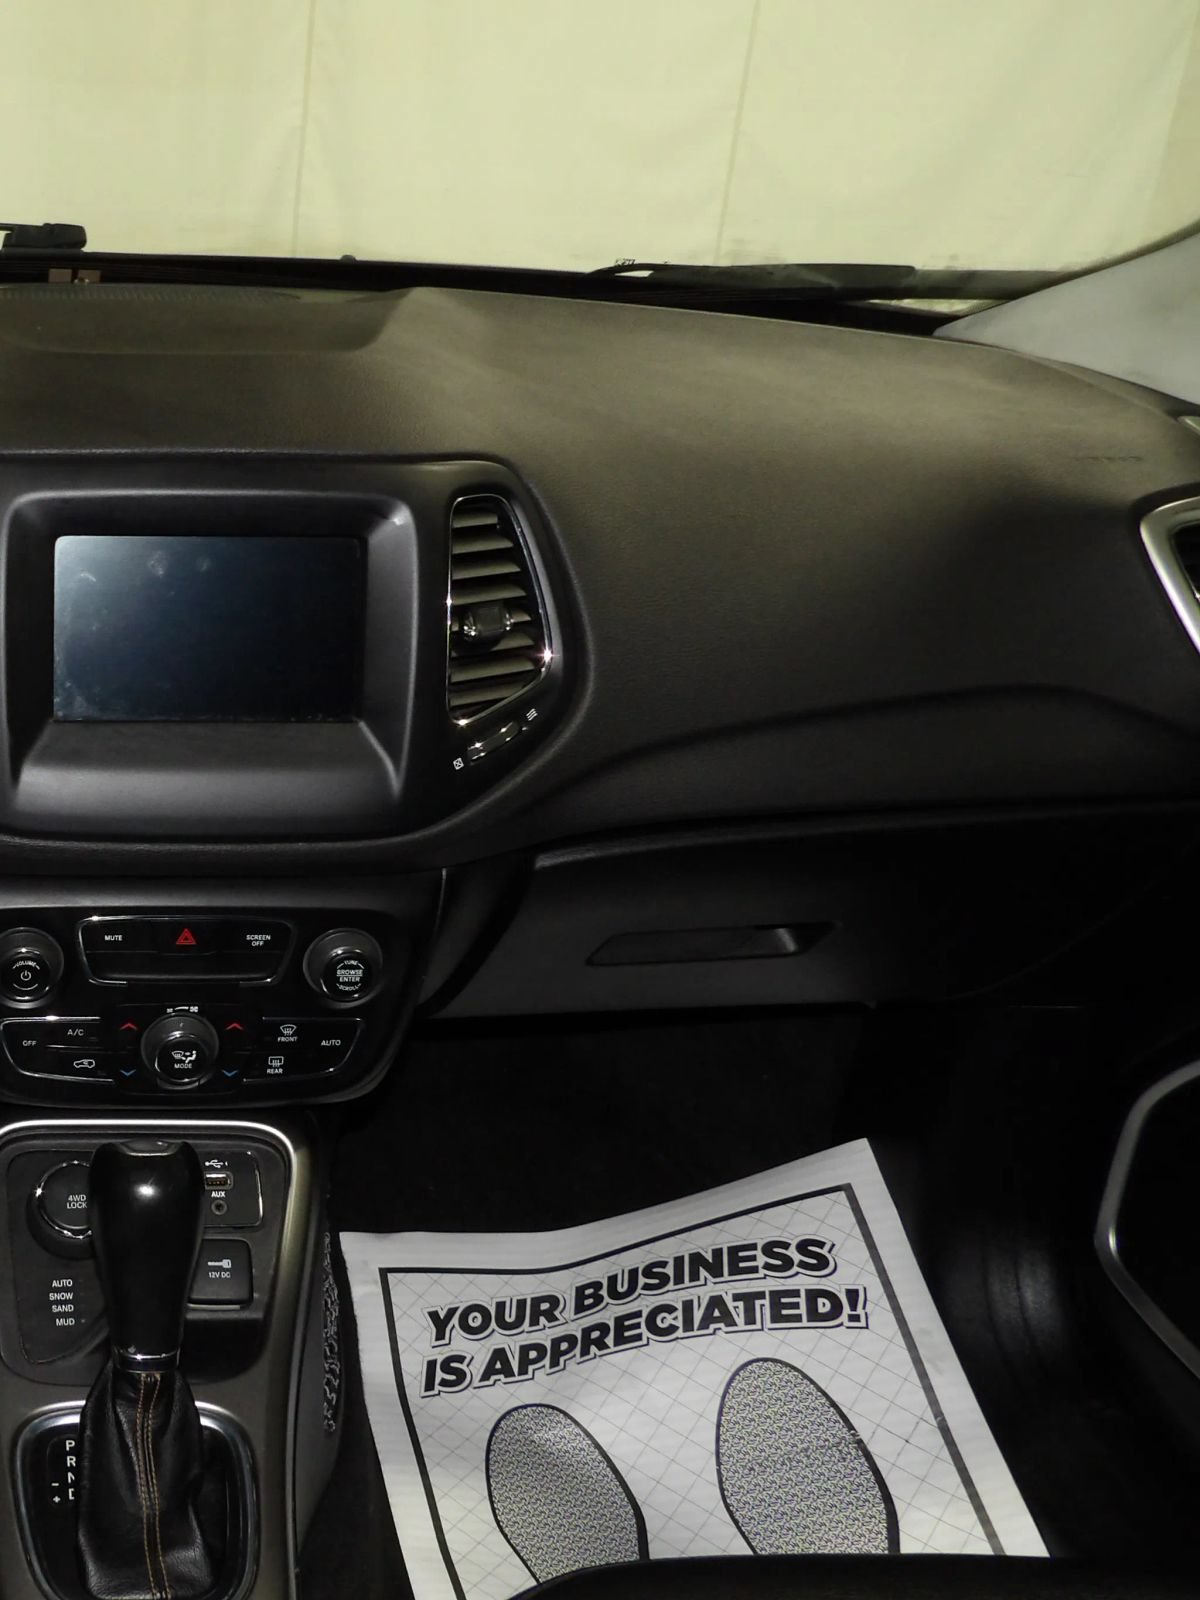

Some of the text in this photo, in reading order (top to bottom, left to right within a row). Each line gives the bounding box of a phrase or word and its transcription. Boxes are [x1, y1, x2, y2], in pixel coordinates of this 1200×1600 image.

[104, 934, 123, 942] MUTE
[66, 1028, 85, 1037] A/C
[22, 1039, 37, 1047] OFF
[320, 1039, 342, 1047] AUTO
[67, 1194, 87, 1202] 4WD
[66, 1201, 88, 1209] LOCK
[208, 1271, 220, 1279] 12V
[51, 1278, 73, 1288] AUTO
[425, 1235, 837, 1347] YOUR BUSINESS
[48, 1291, 74, 1301] SNOW
[51, 1304, 74, 1313] SAND
[55, 1317, 76, 1327] MUD
[420, 1284, 869, 1397] IS APPRECIATED!
[65, 1439, 76, 1452] P
[66, 1455, 77, 1468] R
